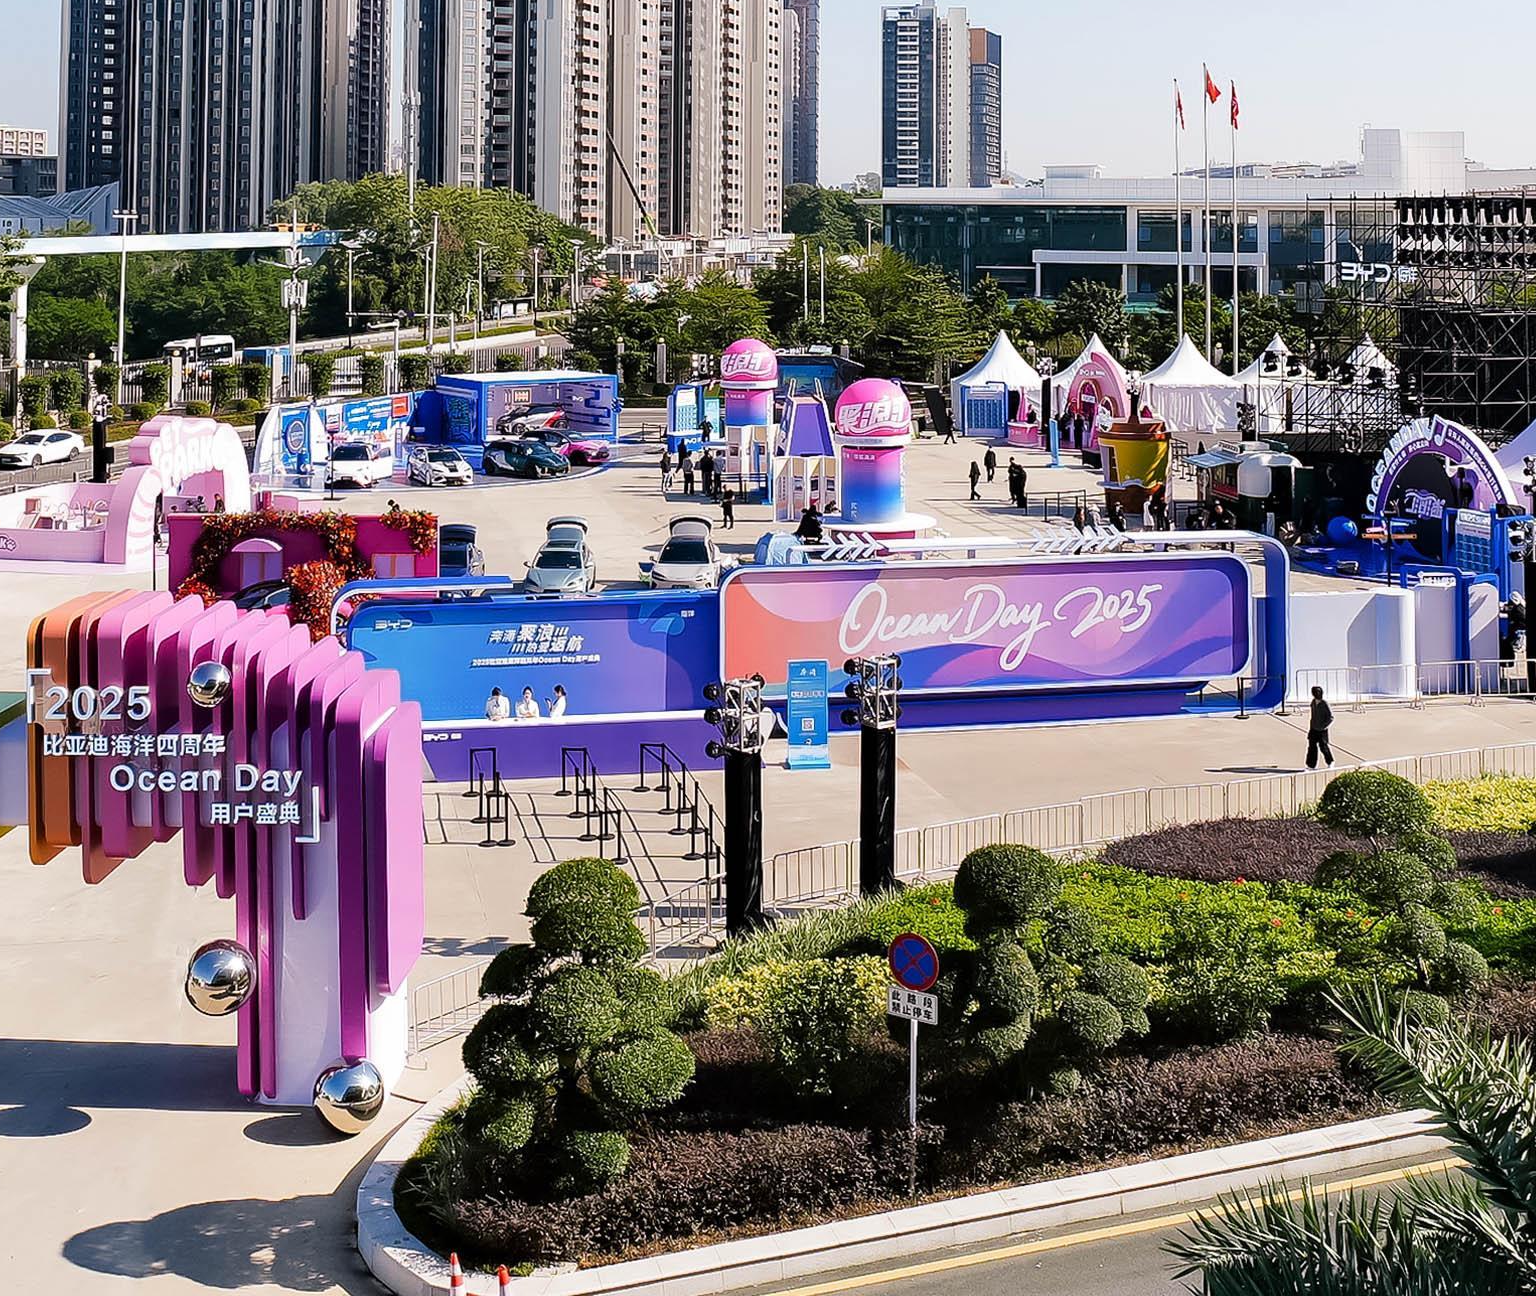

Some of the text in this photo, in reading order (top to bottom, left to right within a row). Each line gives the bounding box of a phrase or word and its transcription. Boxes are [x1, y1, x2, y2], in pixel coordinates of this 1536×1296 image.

[1341, 262, 1392, 282] BYD
[375, 619, 413, 630] BYD
[838, 582, 1162, 671] Ocean Day 2025
[43, 733, 226, 756] 比亚迪海洋四周年
[109, 764, 303, 797] Ocean Day
[210, 802, 300, 825] 用户盛典
[891, 989, 933, 1009] 此路段
[891, 1001, 933, 1020] 禁止停车
